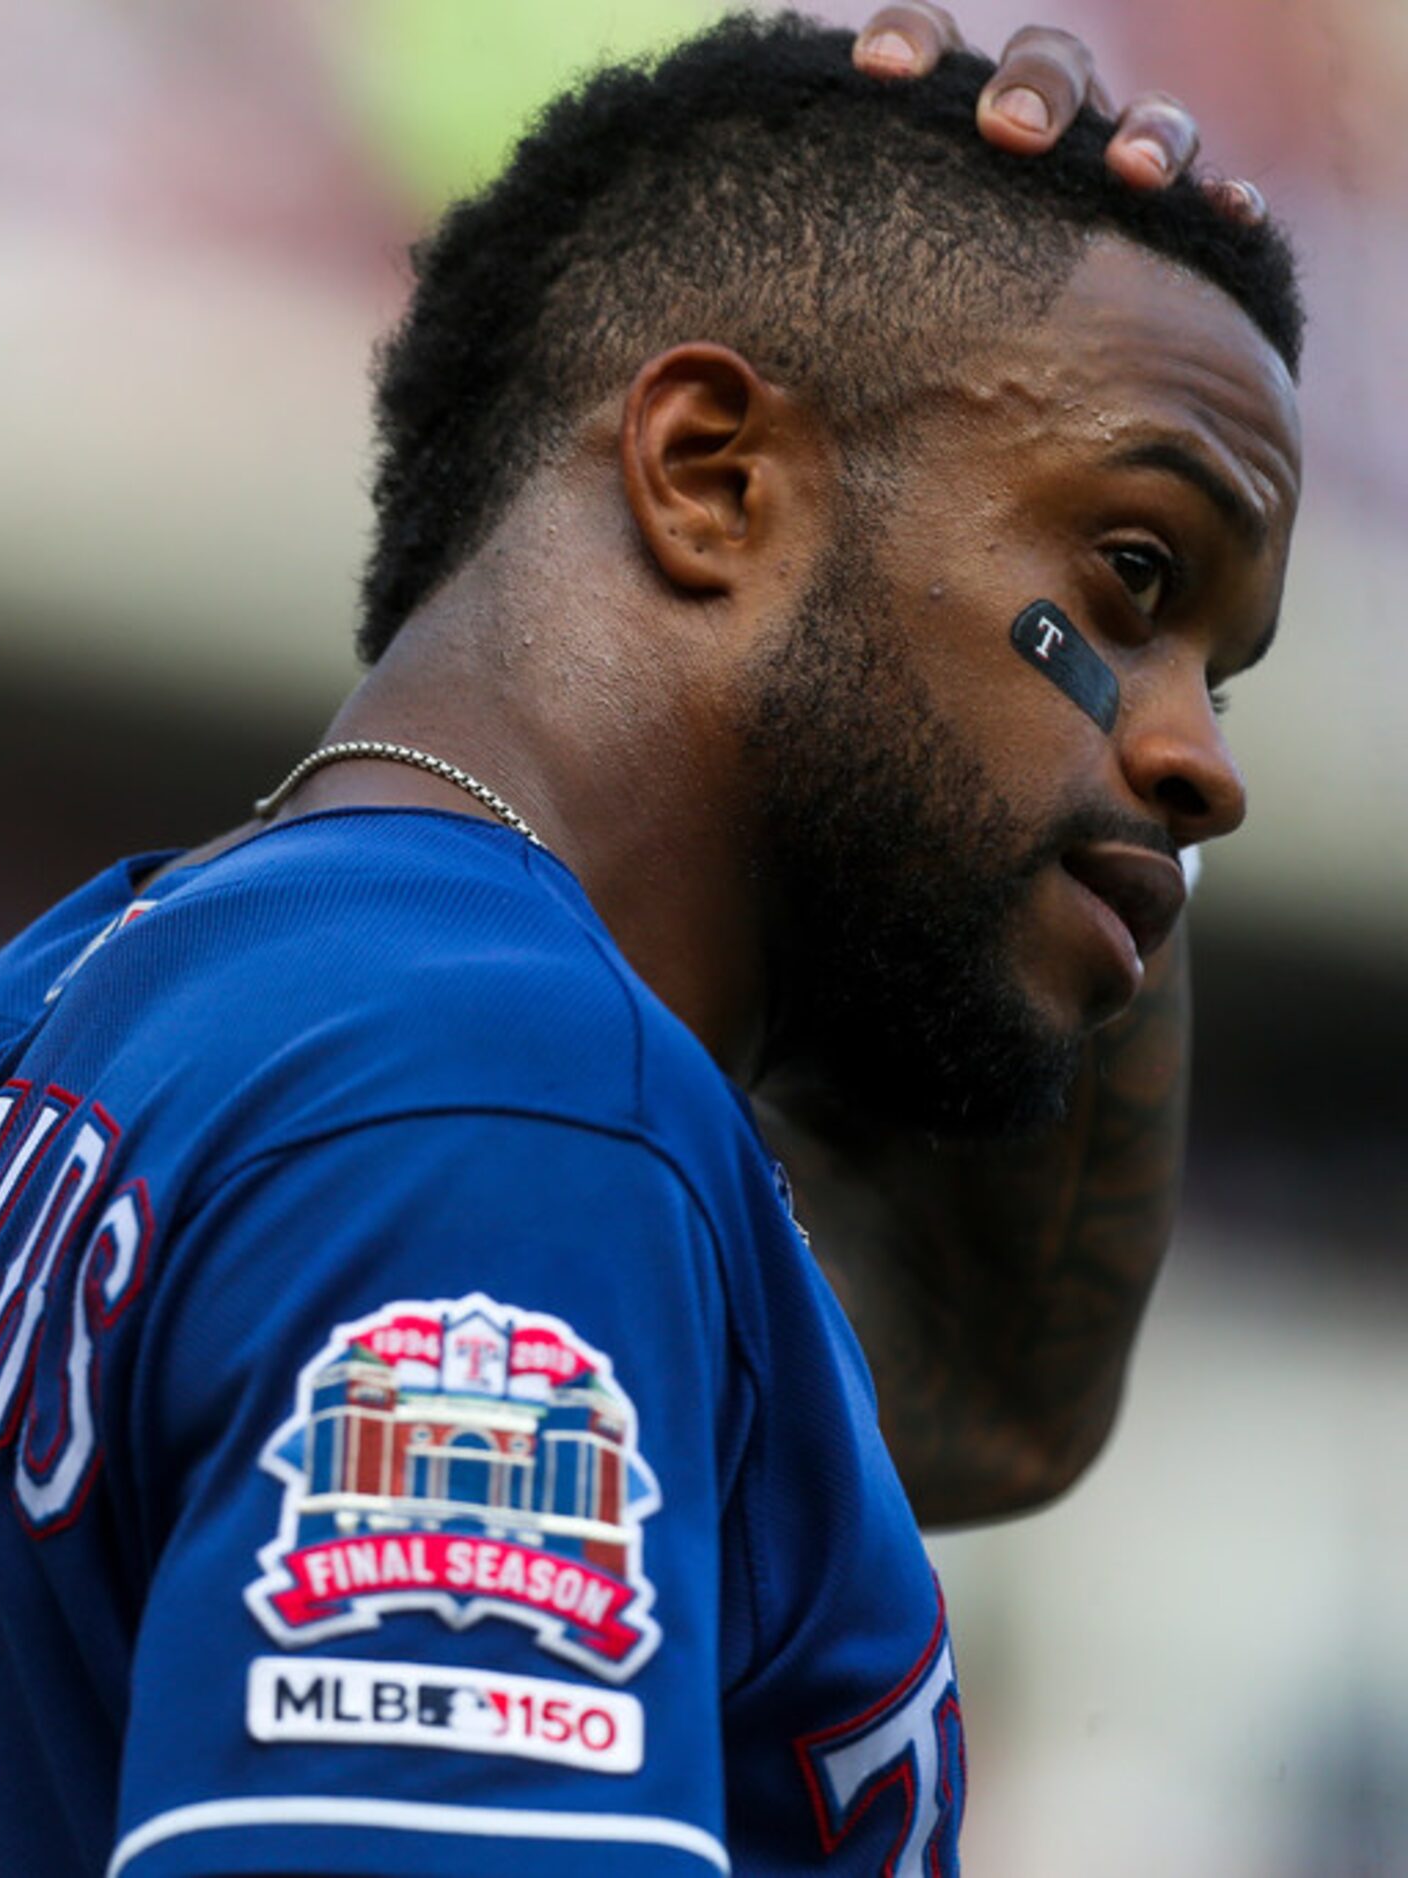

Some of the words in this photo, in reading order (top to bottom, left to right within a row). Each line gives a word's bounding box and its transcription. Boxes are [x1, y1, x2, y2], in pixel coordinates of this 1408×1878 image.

[1035, 616, 1064, 660] T
[305, 1539, 435, 1597] FINAL
[445, 1541, 615, 1624] SEASON
[275, 1677, 409, 1724] MLB
[519, 1695, 616, 1752] 150
